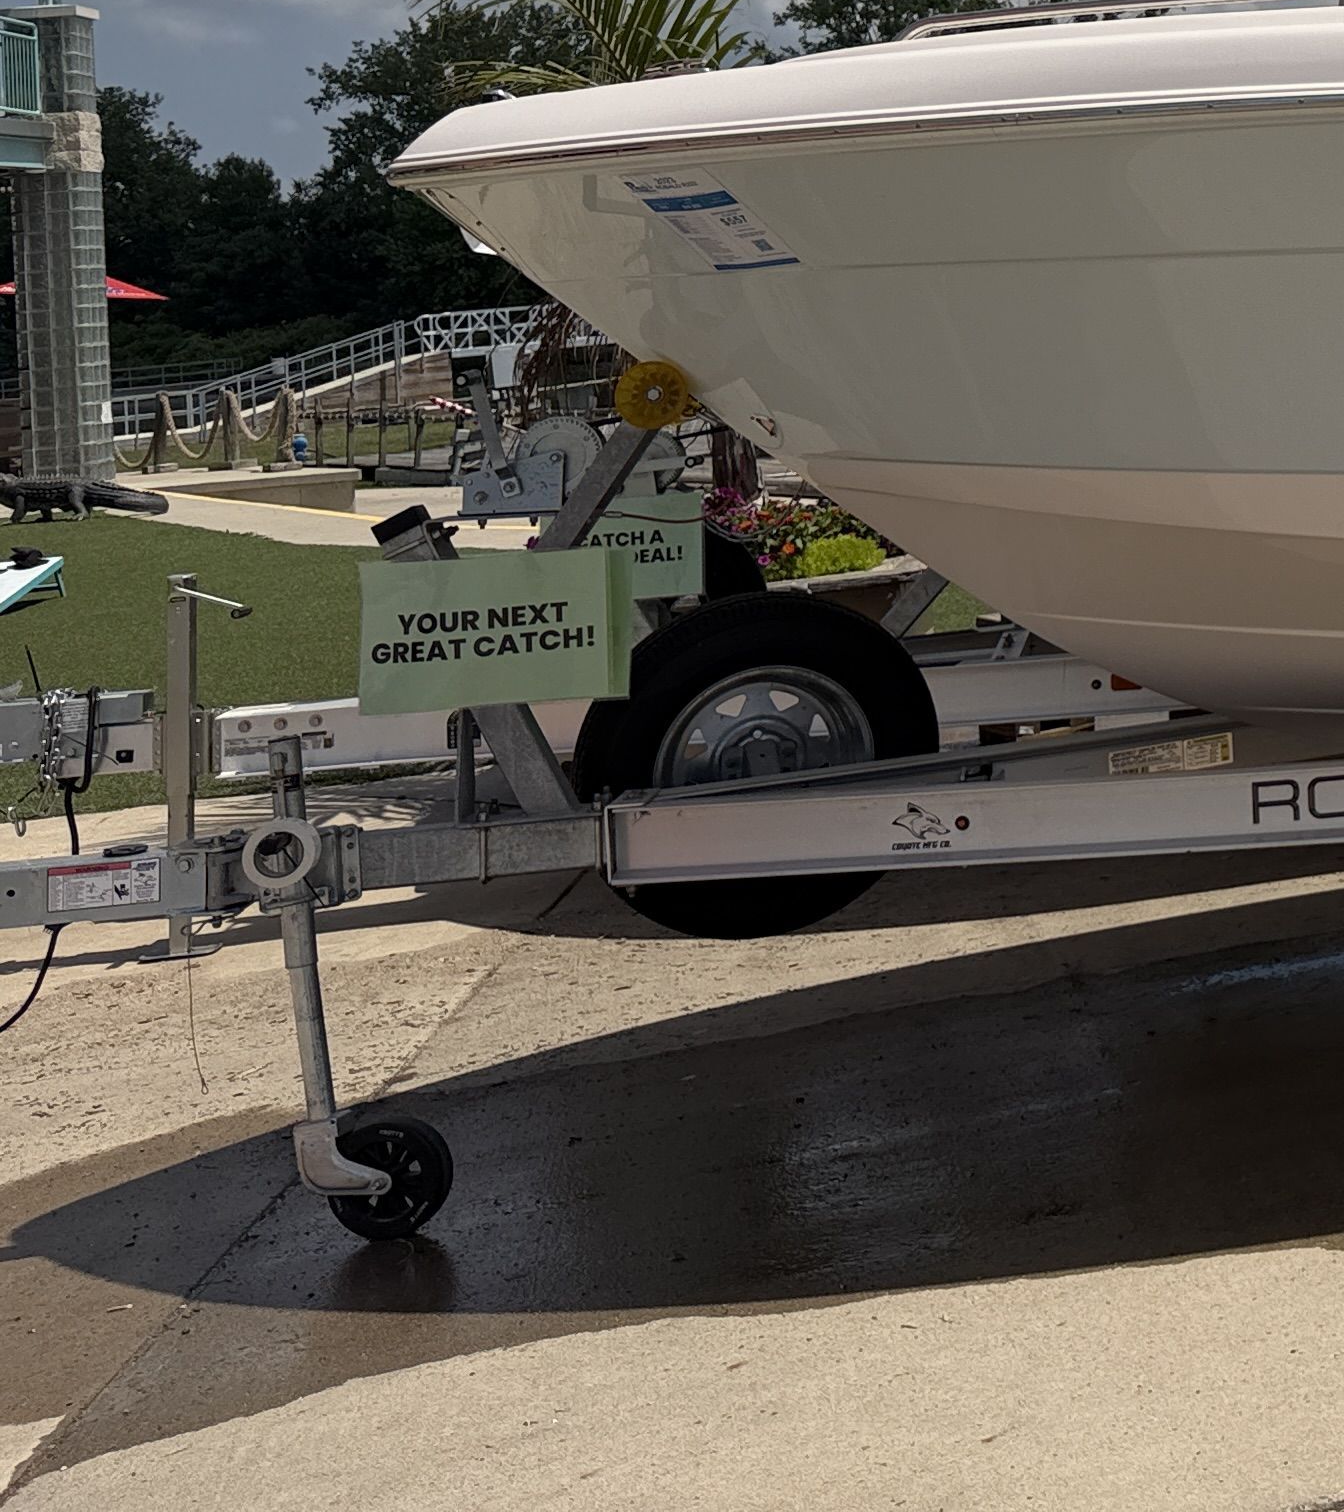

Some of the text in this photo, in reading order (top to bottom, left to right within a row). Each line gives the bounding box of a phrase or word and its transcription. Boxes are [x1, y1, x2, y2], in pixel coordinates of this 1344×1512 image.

[649, 529, 664, 545] A
[397, 601, 569, 636] YOUR NEXT
[371, 625, 595, 665] GREAT CATCH!
